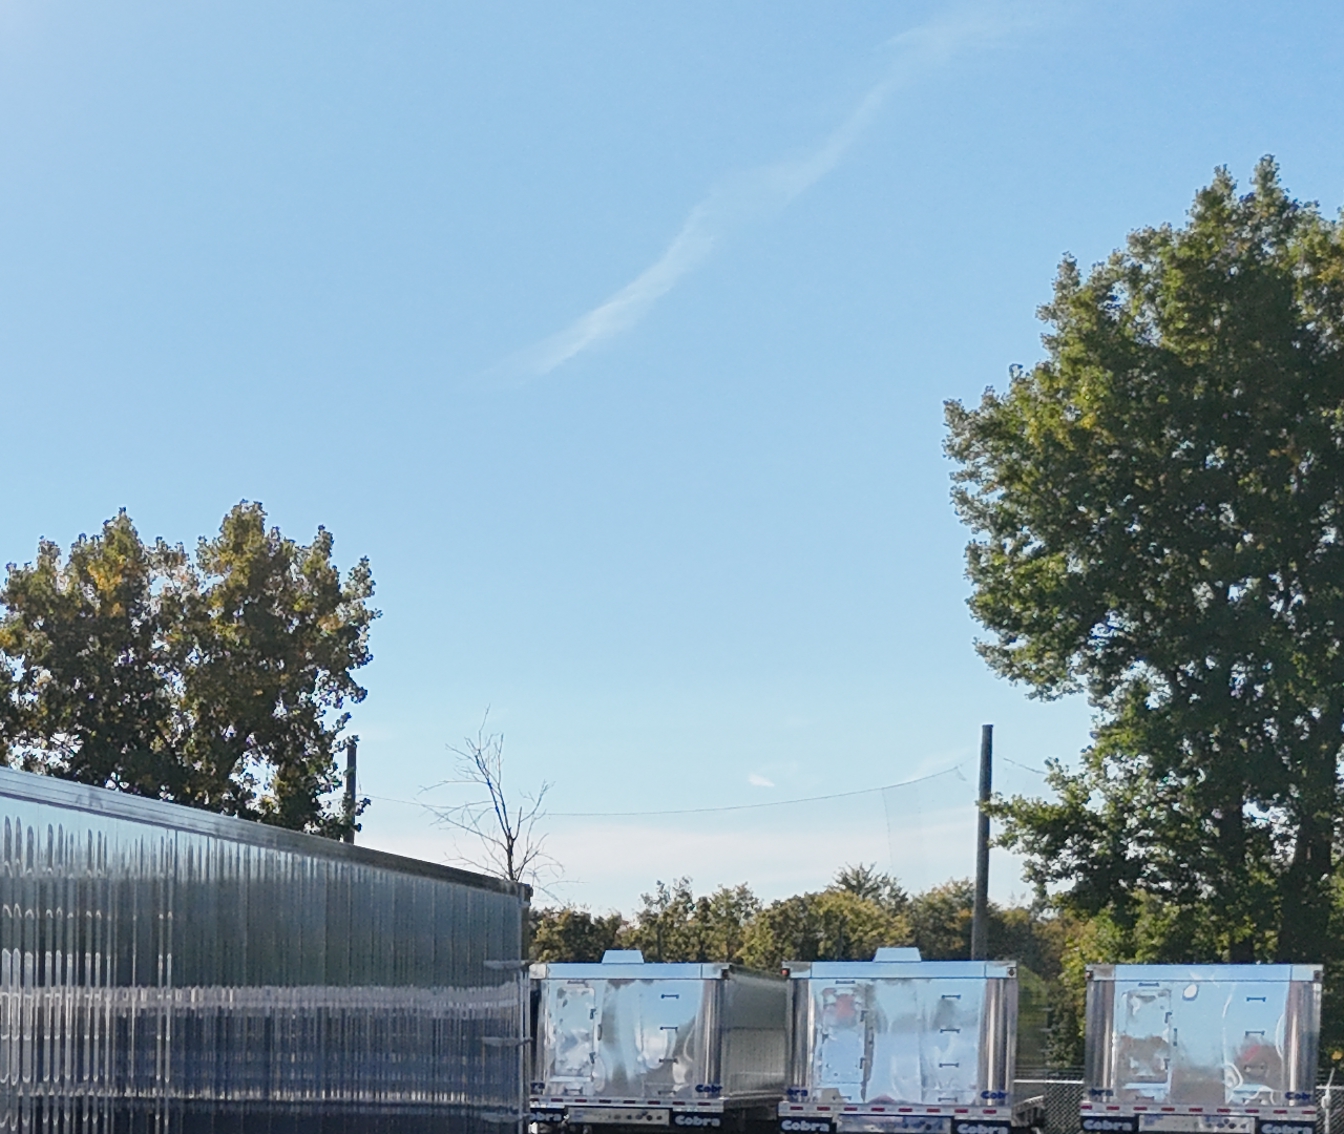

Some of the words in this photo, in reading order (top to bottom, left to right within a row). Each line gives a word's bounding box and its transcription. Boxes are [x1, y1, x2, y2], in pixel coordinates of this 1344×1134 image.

[674, 1114, 721, 1127] Cobra
[781, 1119, 831, 1132] Cobra
[1083, 1119, 1132, 1132] Cobra
